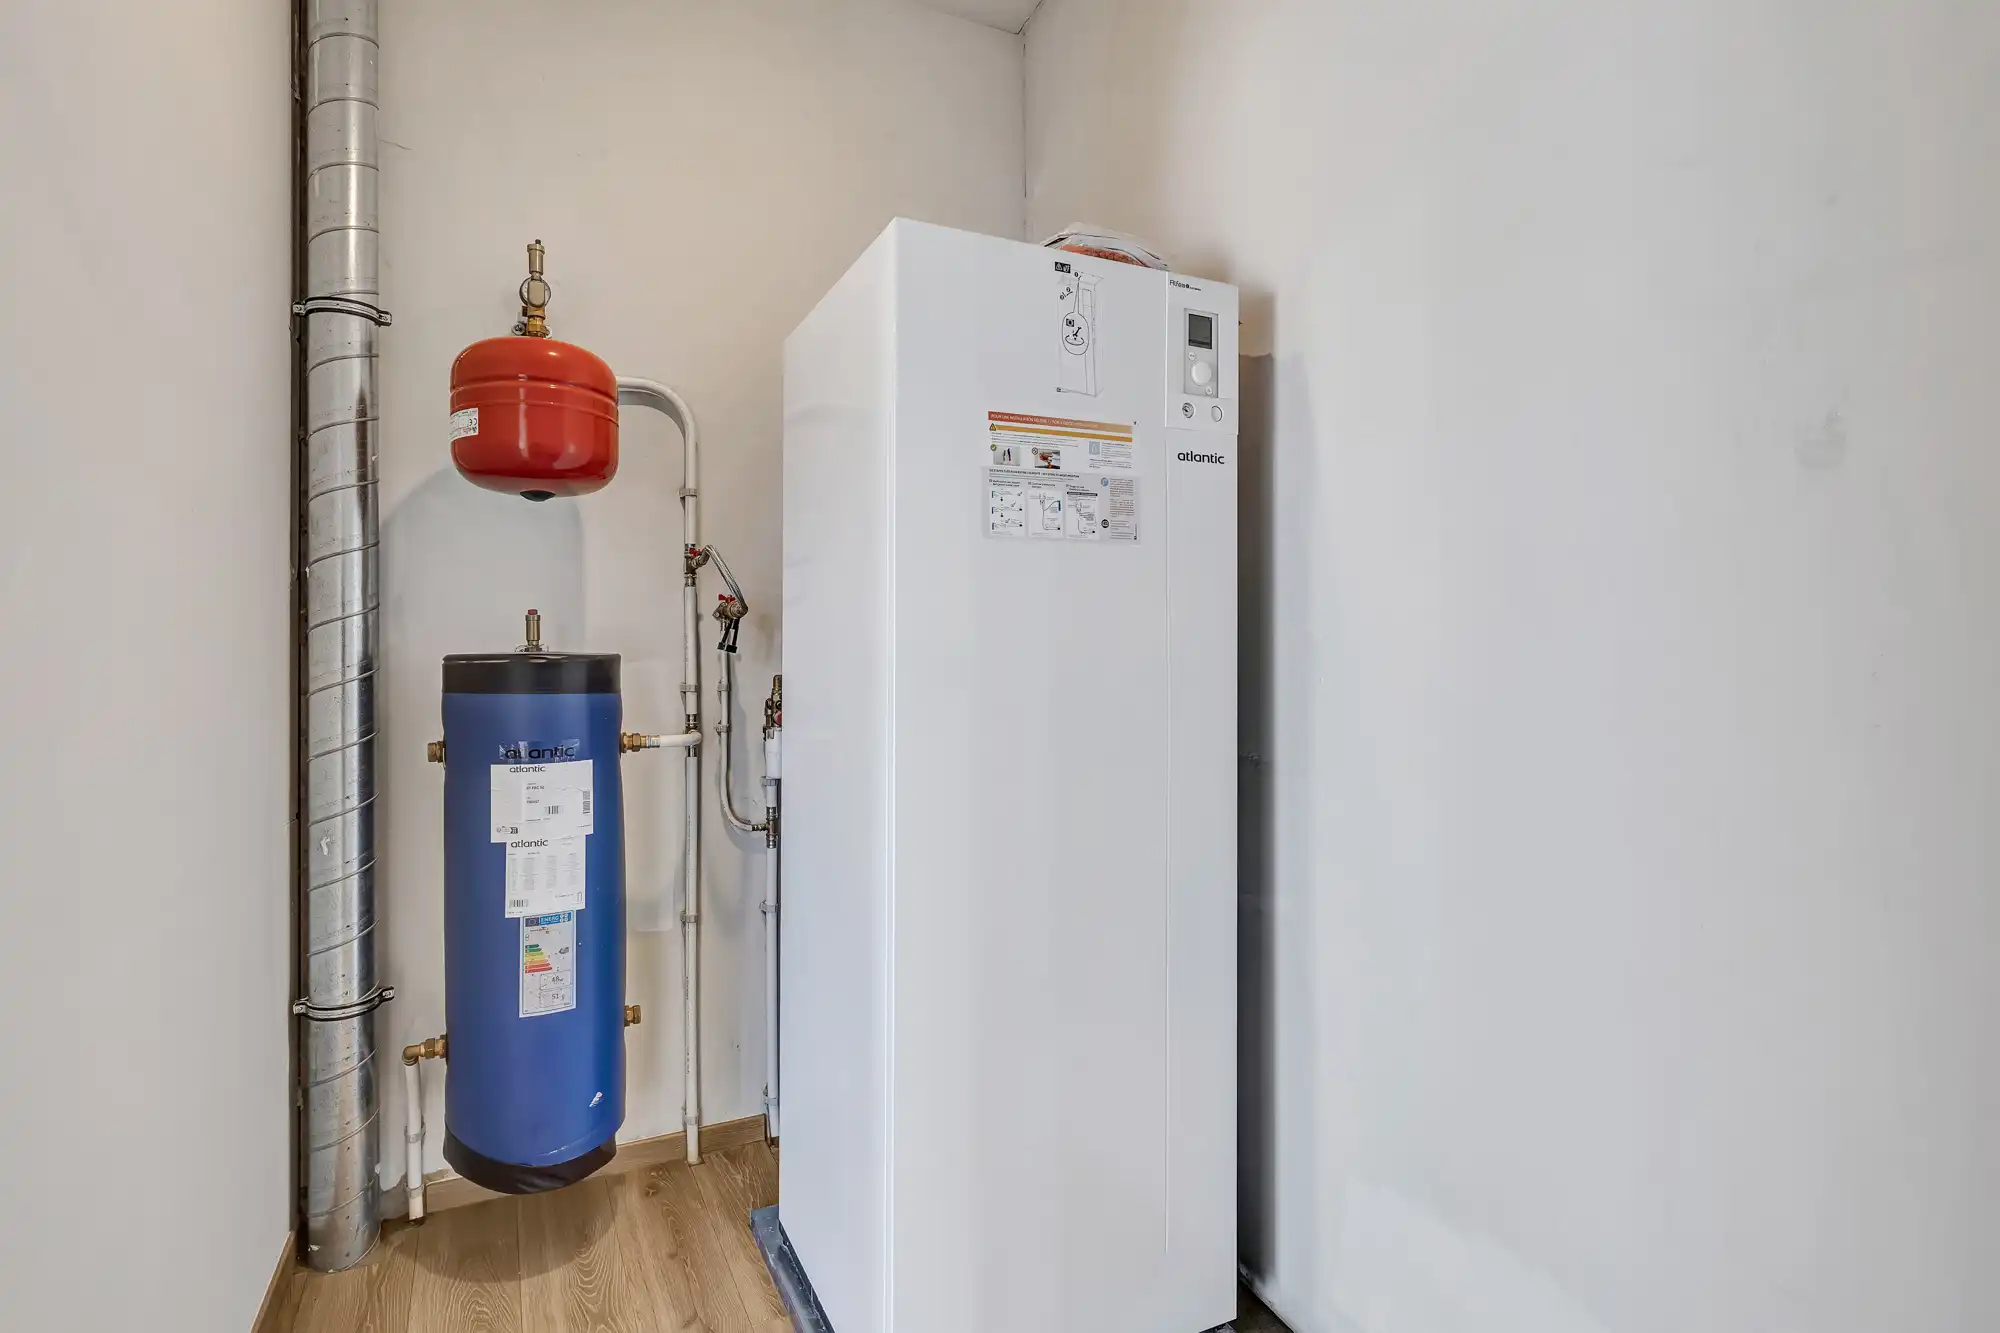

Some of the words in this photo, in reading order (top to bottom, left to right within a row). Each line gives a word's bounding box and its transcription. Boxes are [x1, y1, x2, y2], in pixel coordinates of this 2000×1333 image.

[1177, 450, 1224, 464] atlantic
[509, 765, 546, 773] atlantic
[510, 838, 549, 848] atlantic
